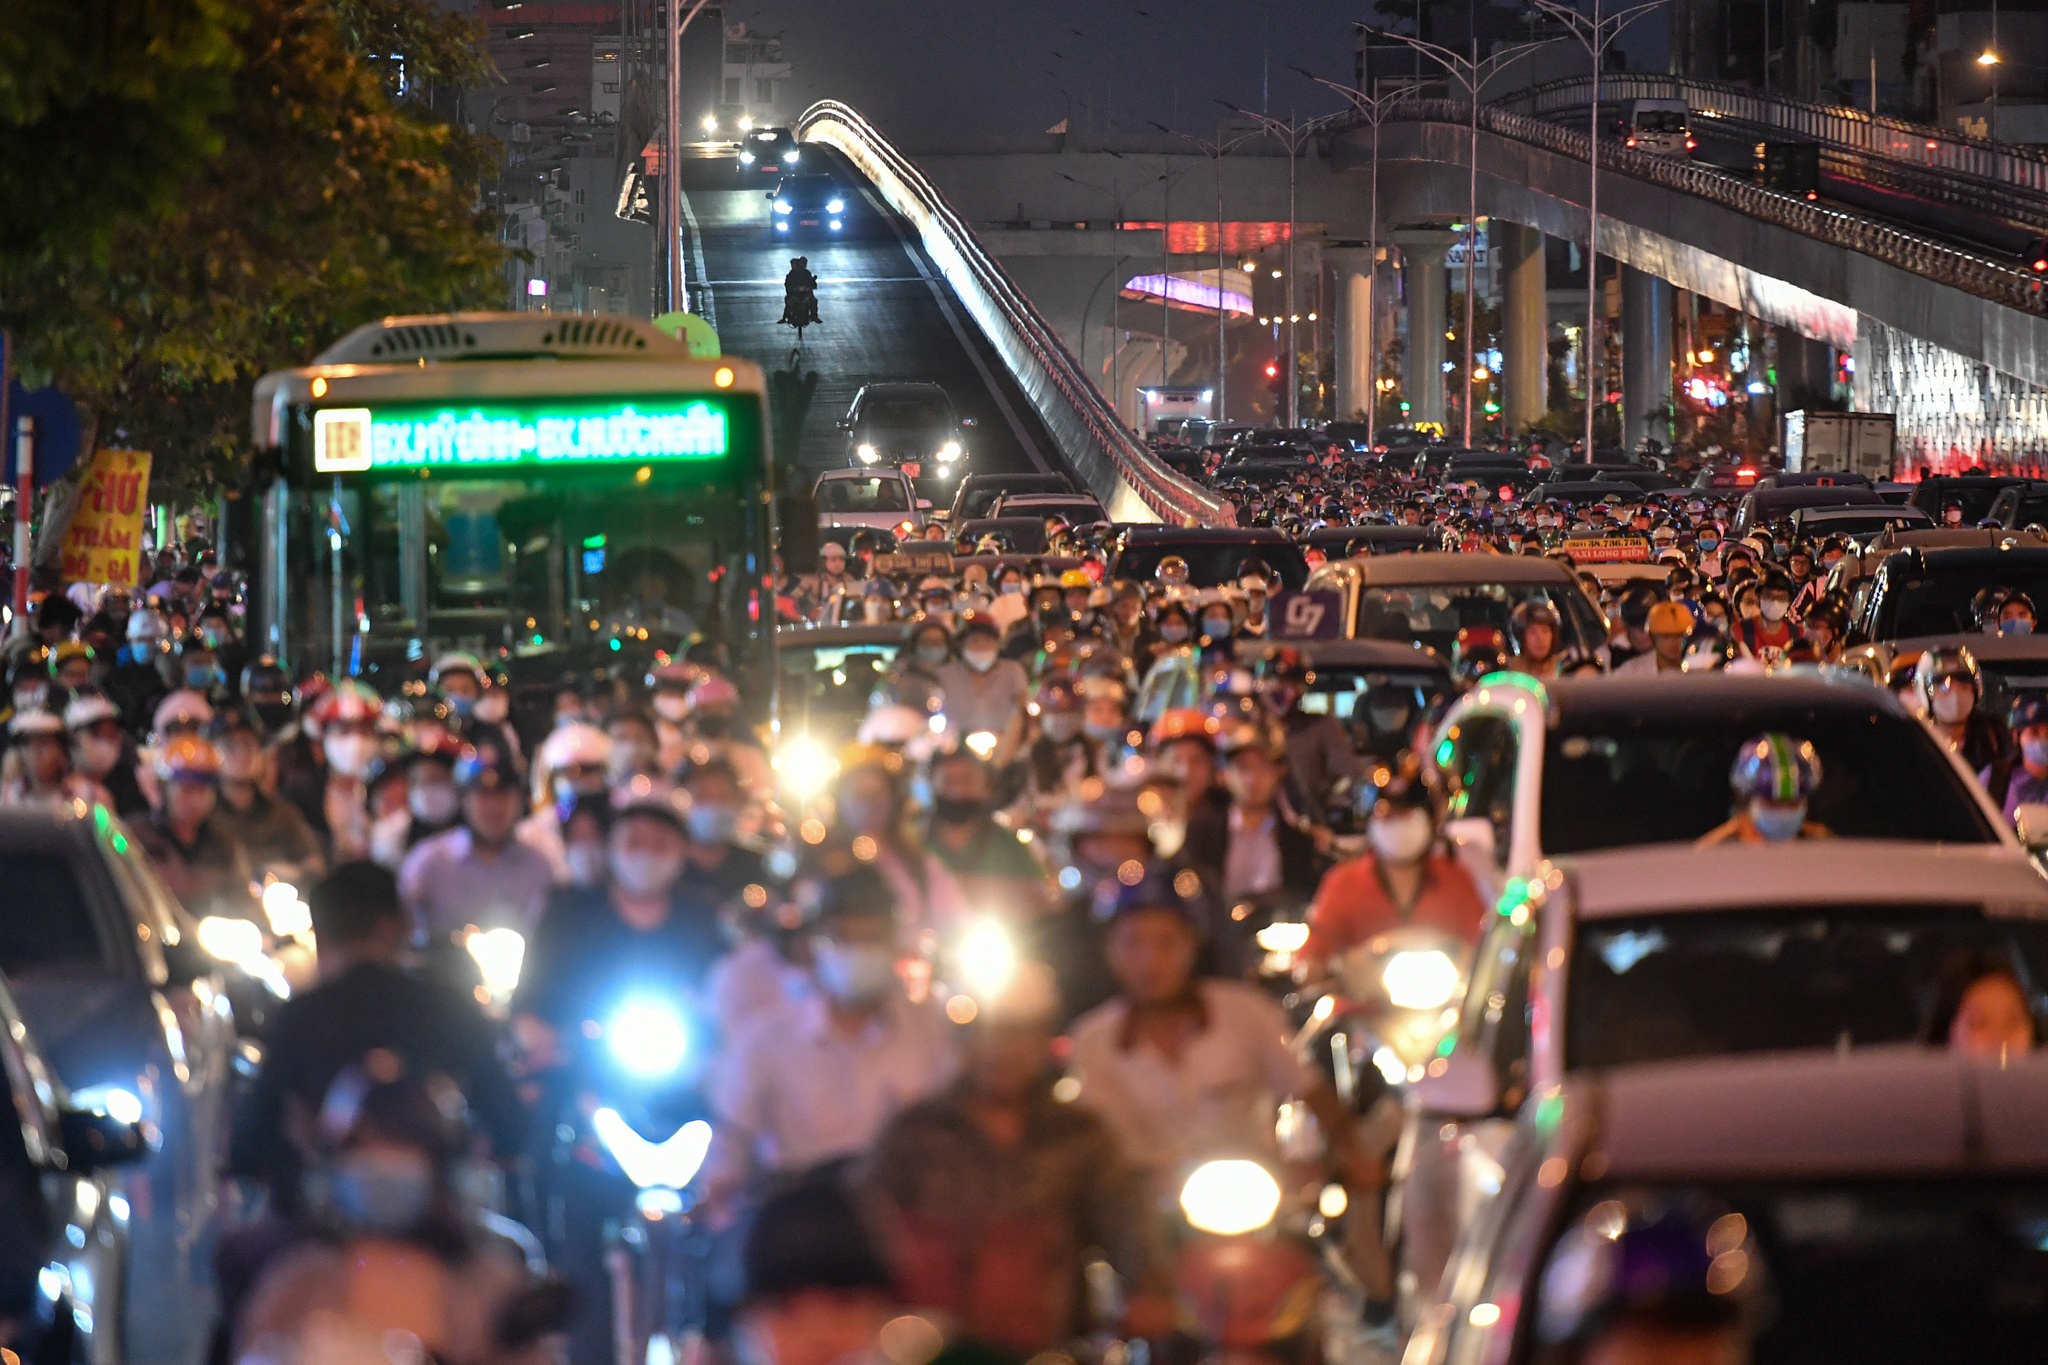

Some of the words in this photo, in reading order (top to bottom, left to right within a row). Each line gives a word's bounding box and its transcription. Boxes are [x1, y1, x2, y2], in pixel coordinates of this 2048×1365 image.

[1570, 549, 1591, 558] TAXI
[1593, 549, 1620, 558] LONG
[1621, 548, 1644, 557] BIÊN
